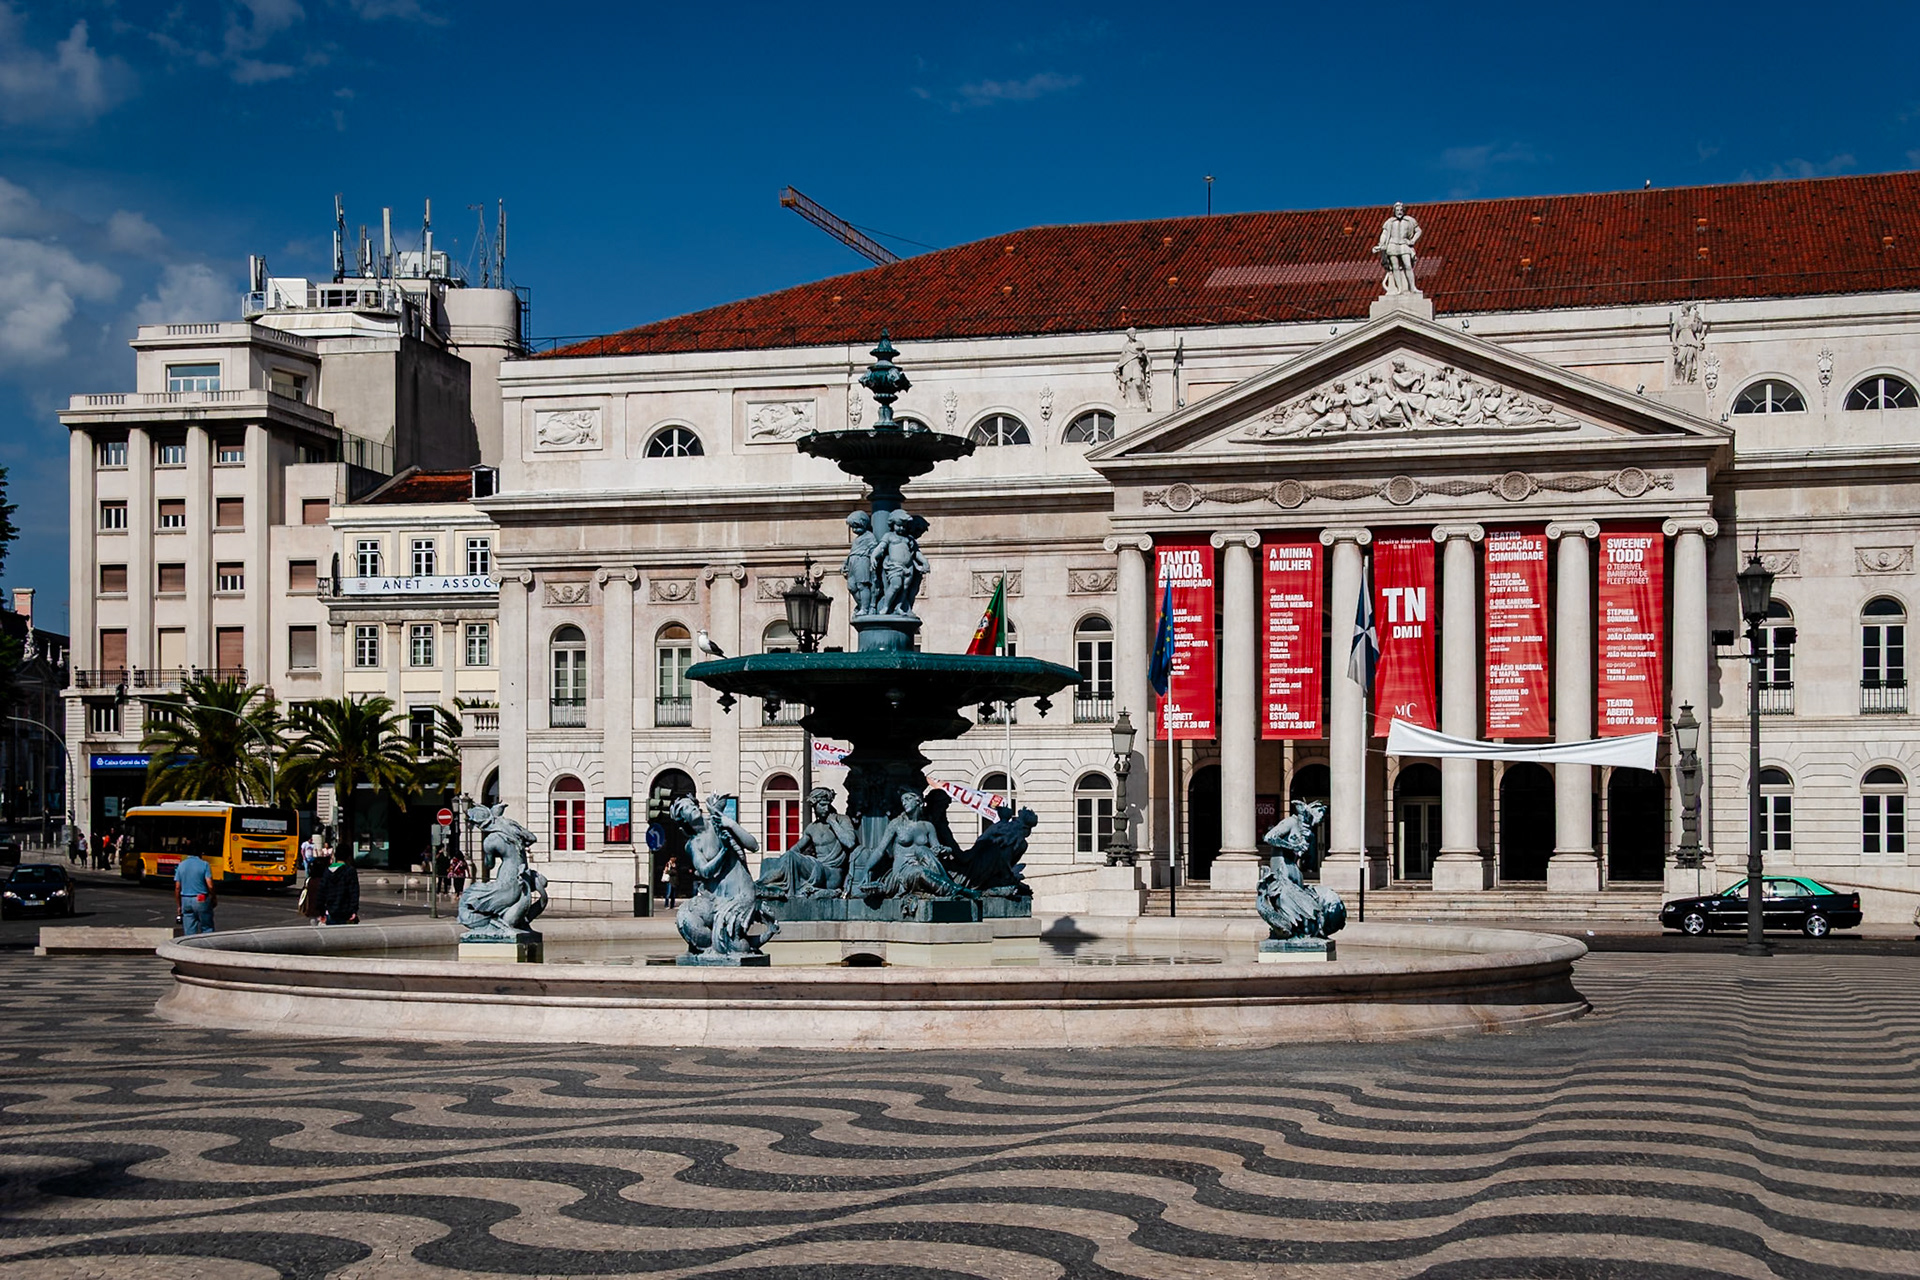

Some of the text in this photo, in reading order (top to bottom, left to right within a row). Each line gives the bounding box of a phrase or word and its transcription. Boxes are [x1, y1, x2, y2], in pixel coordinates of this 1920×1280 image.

[1489, 532, 1520, 540] TEATRO
[1489, 540, 1541, 552] EDUCAÇÃO E
[1607, 538, 1652, 548] SWEENEY
[1159, 550, 1200, 564] TANTO
[1270, 548, 1313, 559] A MINHA
[1489, 552, 1544, 561] COMUNIDADE
[1607, 549, 1643, 563] TODD
[1159, 564, 1203, 578] AMOR
[1270, 560, 1311, 571] MULHER
[383, 580, 421, 589] ANET
[1382, 587, 1426, 622] TN
[1270, 710, 1300, 720] ESTÚDIO
